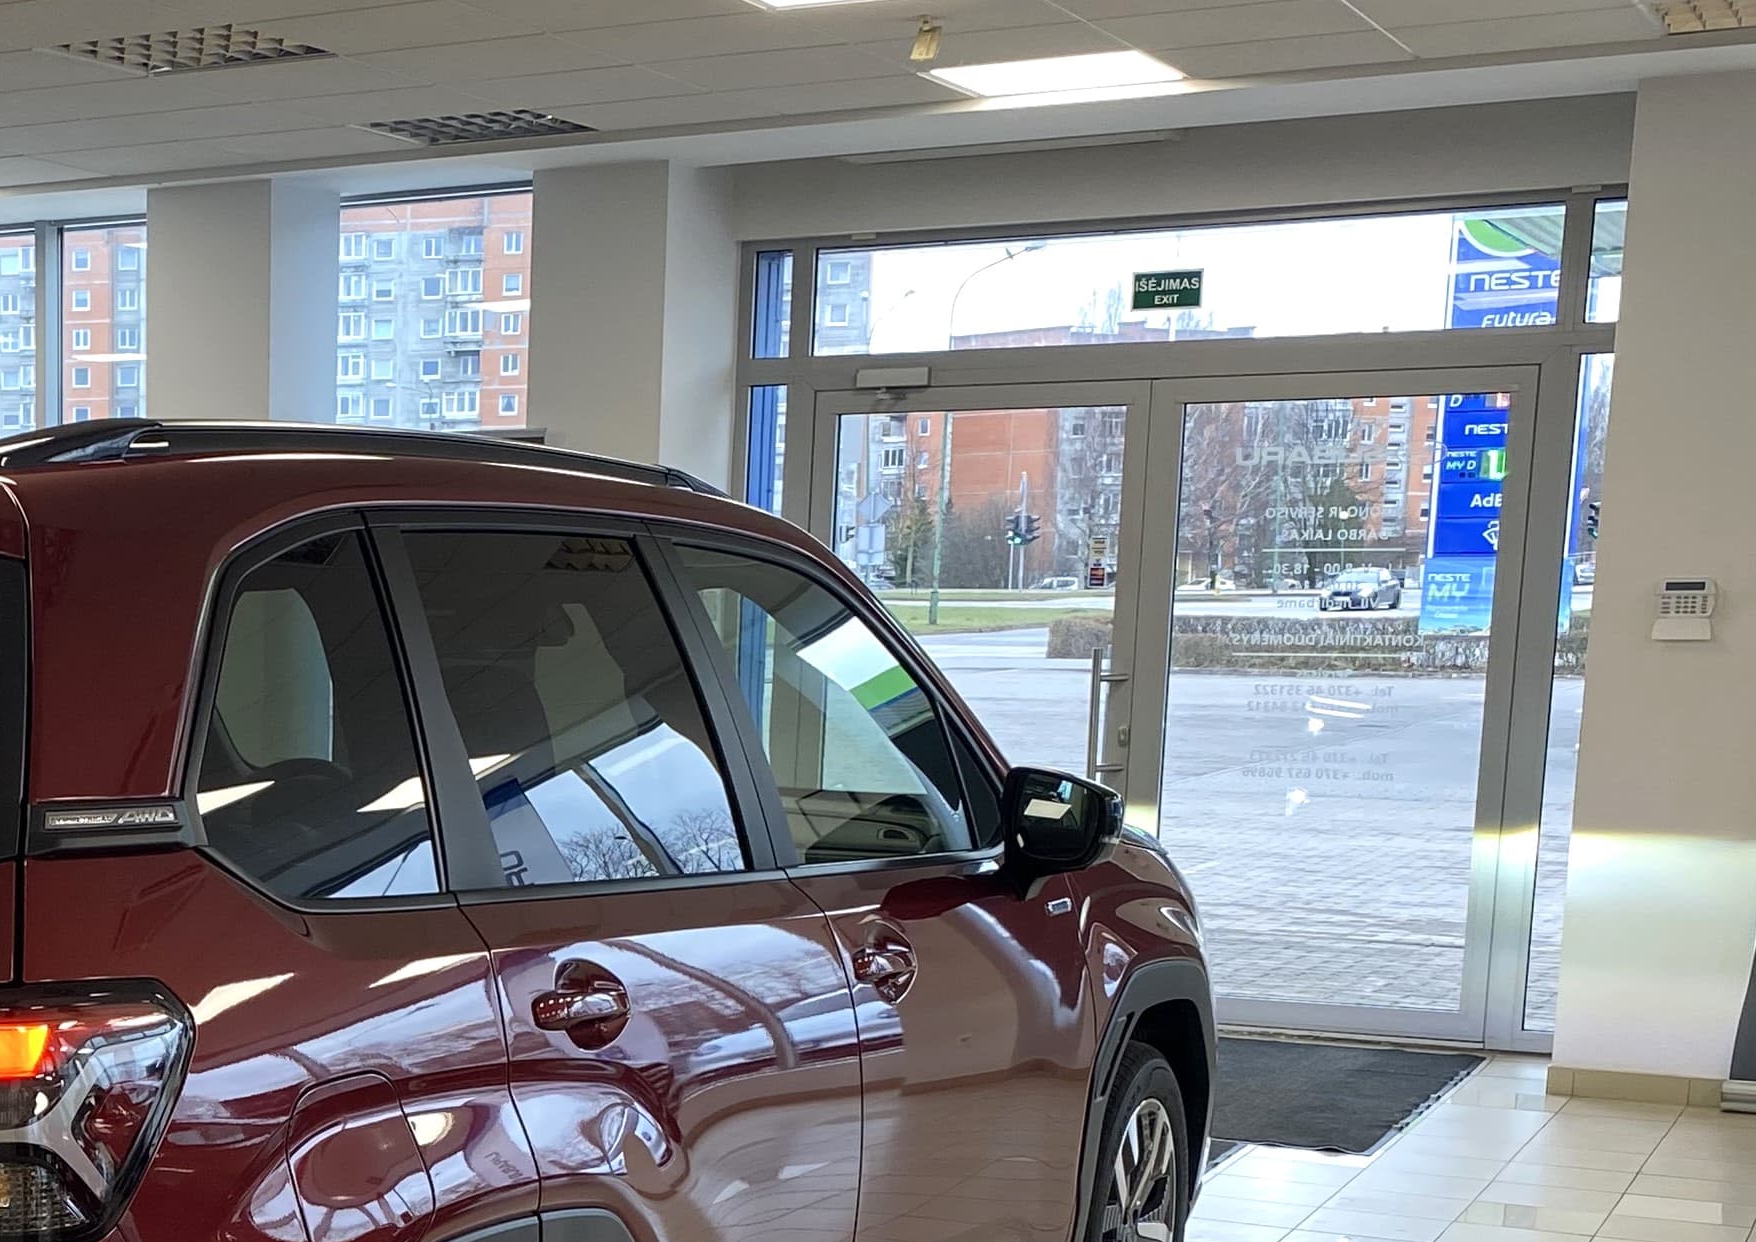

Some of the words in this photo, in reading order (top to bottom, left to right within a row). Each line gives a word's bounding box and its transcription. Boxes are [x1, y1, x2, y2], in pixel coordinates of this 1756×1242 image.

[1135, 277, 1200, 292] IŠĖJIMAS
[1154, 294, 1179, 305] EXIT
[1446, 461, 1465, 470] MY
[1467, 460, 1477, 470] D
[1428, 573, 1471, 582] NESTE
